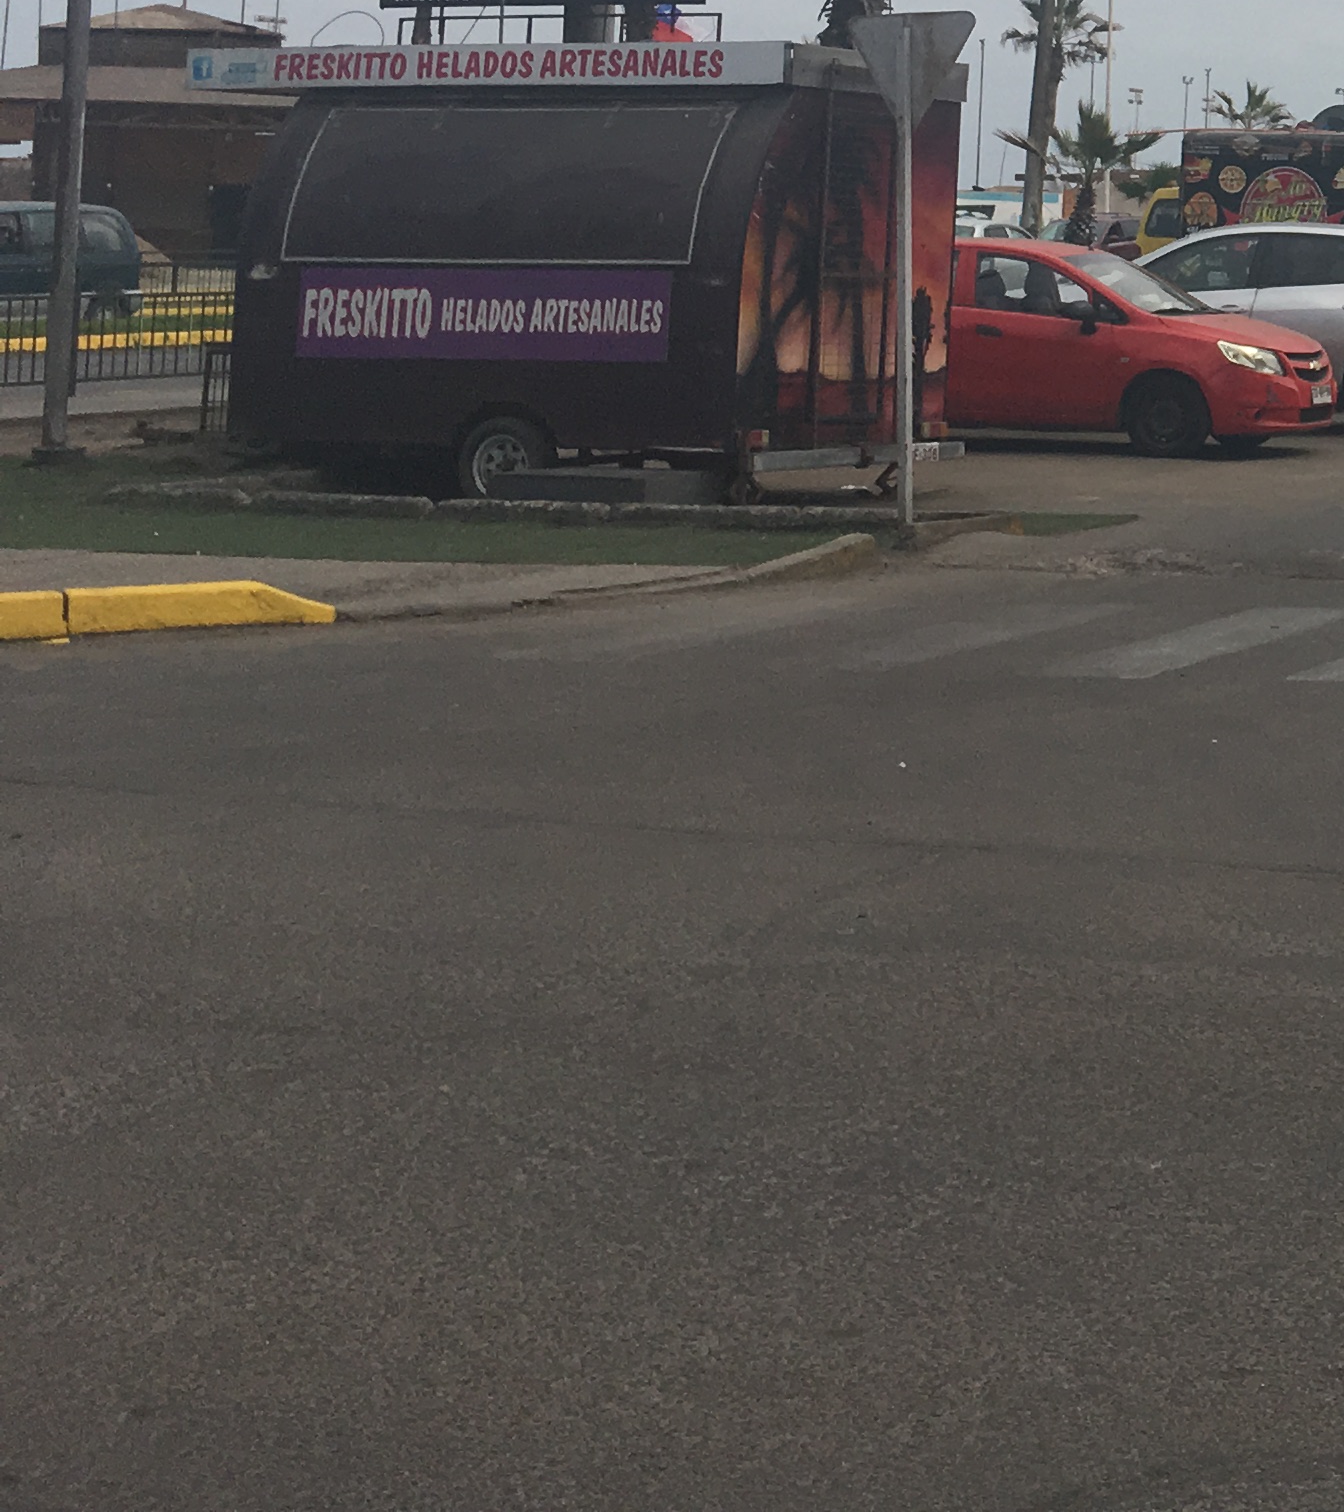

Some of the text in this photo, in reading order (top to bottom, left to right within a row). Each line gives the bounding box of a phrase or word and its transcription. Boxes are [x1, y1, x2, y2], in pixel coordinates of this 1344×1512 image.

[273, 51, 407, 81] FRESKITTO
[416, 49, 535, 80] HELADOS
[539, 47, 724, 79] ARTESANALES
[302, 286, 664, 338] FRESKITTO HELADOS ARTESANALES
